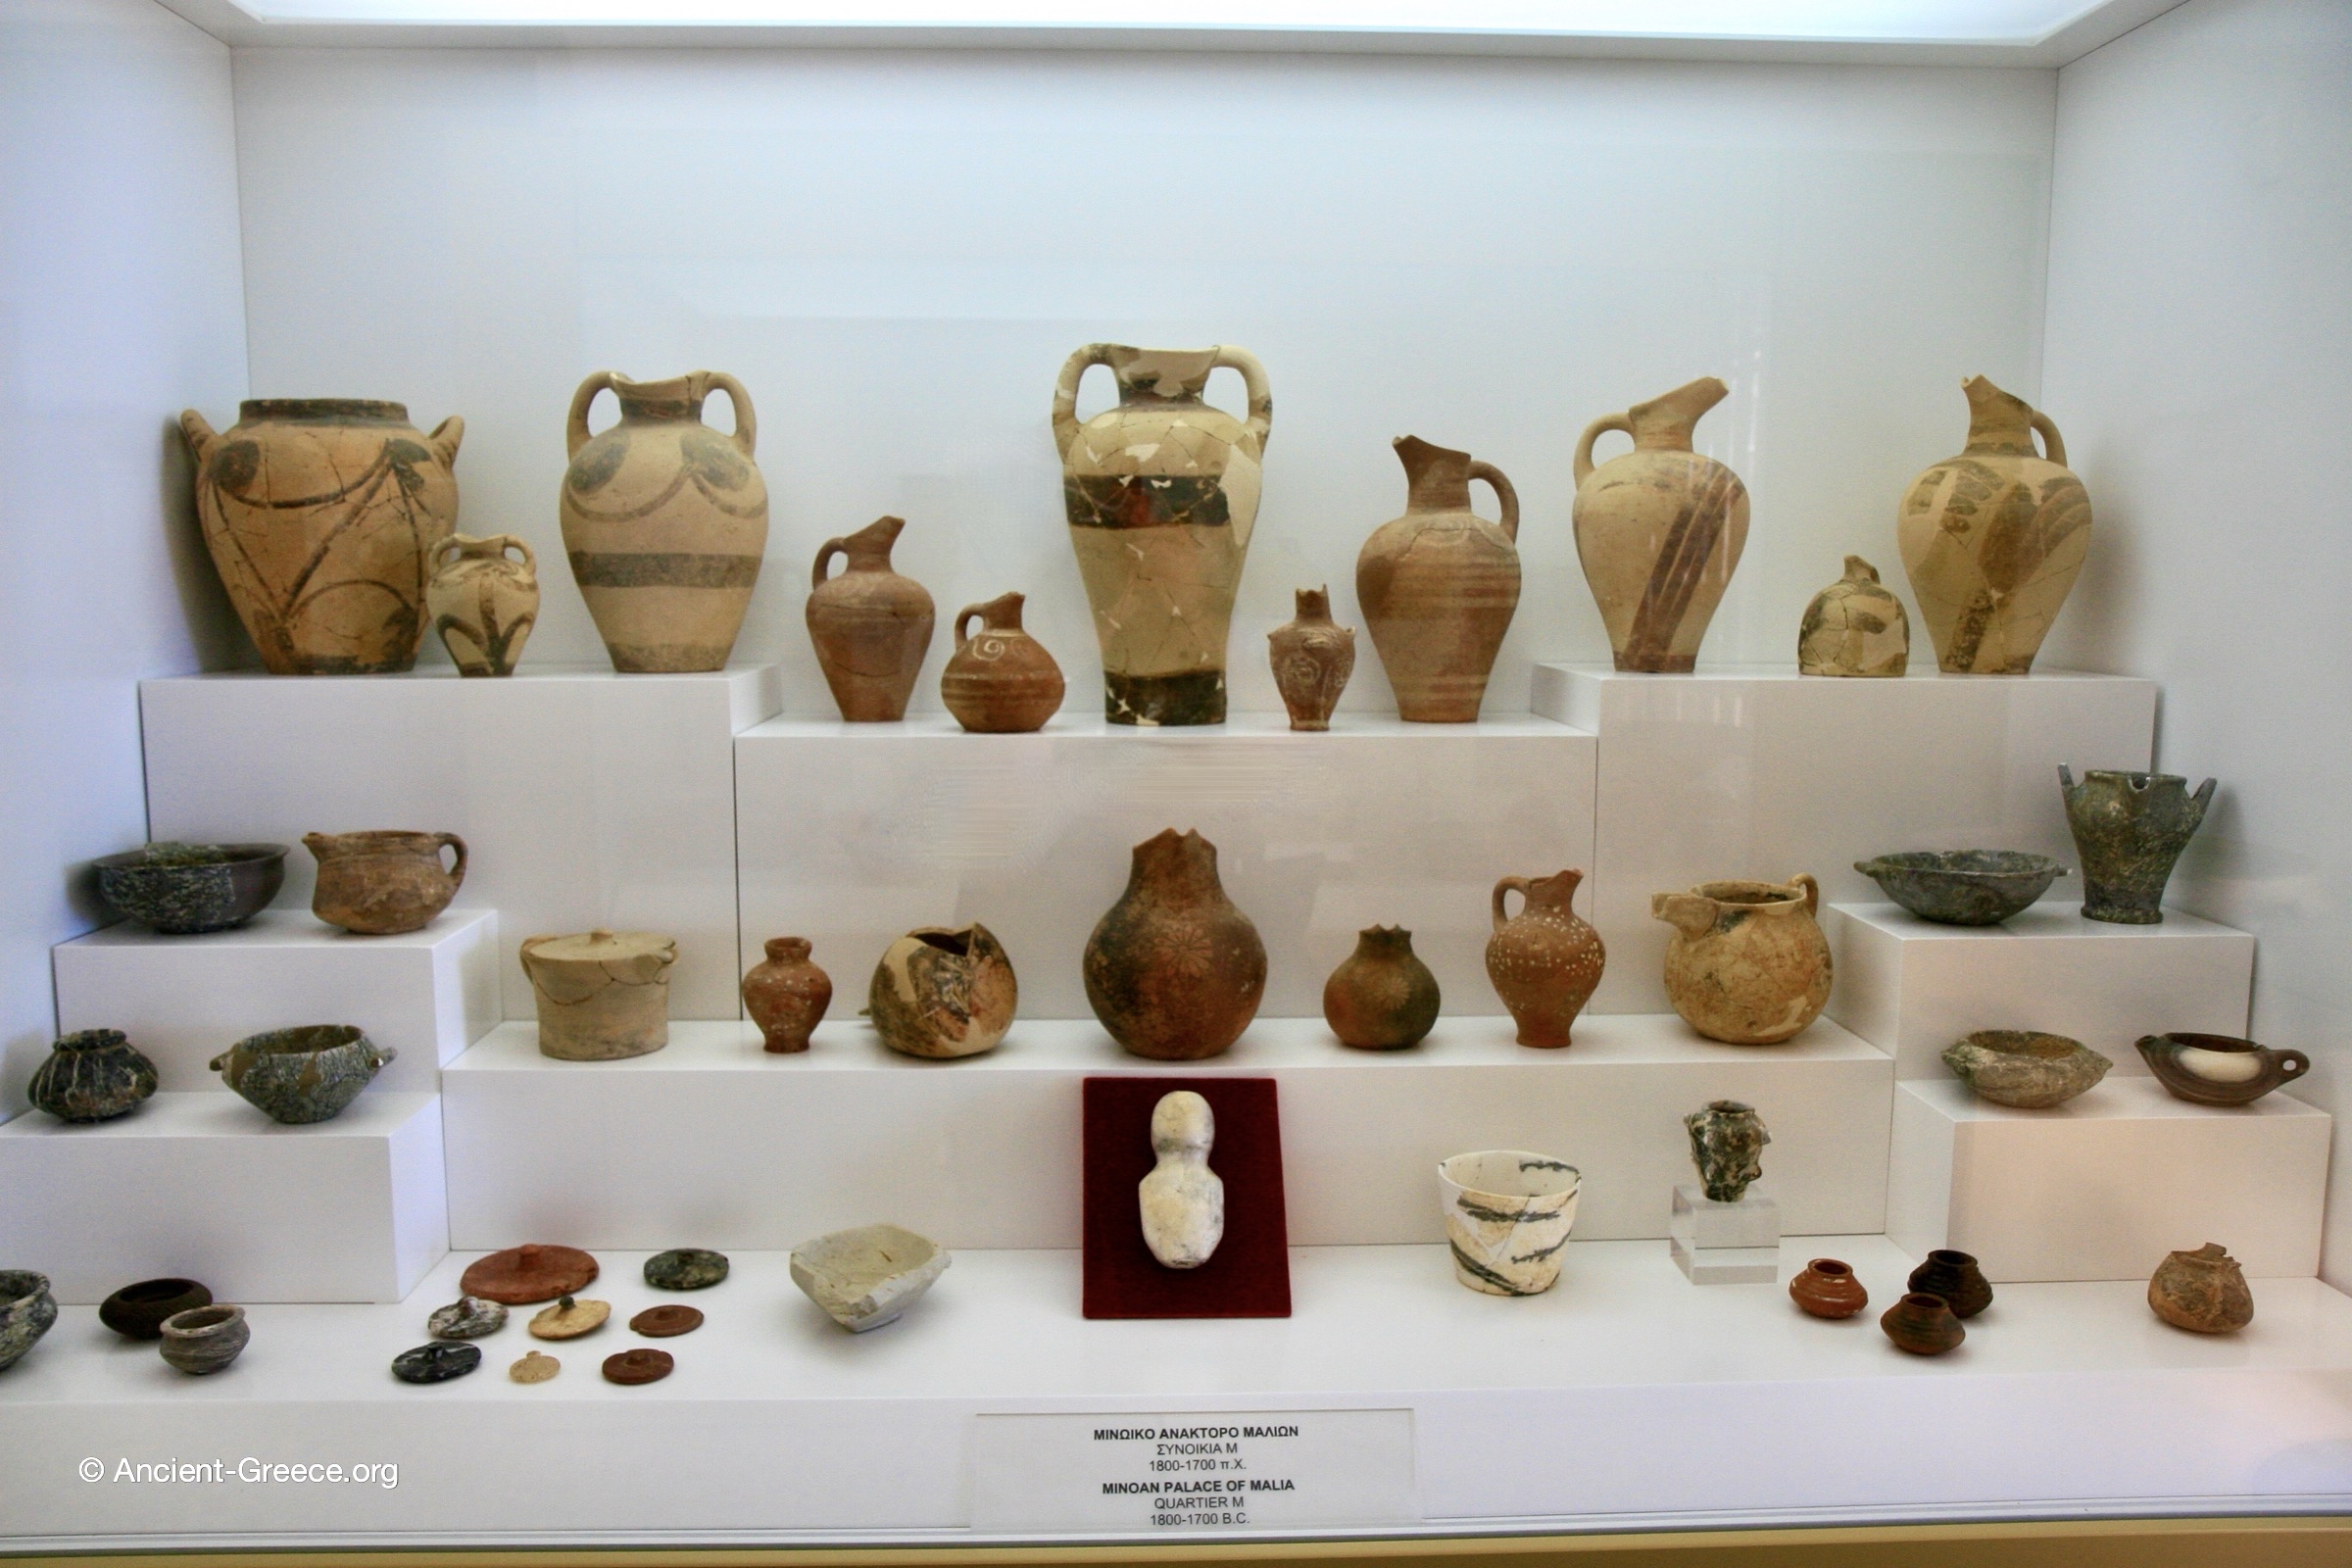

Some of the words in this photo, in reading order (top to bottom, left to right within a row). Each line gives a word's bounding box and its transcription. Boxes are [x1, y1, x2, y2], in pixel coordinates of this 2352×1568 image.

[1094, 1428, 1155, 1441] ΜΙΝΩΙΚΟ
[1159, 1427, 1239, 1440] ΑΝΑΚΤΟΡΟ
[1243, 1426, 1298, 1438] ΜΑΛΙΩΝ
[1156, 1444, 1222, 1455] ΣΥΝΟΙΚΙΑ
[1150, 1459, 1216, 1472] 1800-1700
[1220, 1458, 1247, 1470] π.Χ.
[1102, 1482, 1159, 1494] MINOAN
[1164, 1481, 1222, 1493] PALACE
[1226, 1480, 1246, 1492] OF
[1250, 1480, 1295, 1491] MALIA
[1154, 1497, 1228, 1510] QUARTIER
[1232, 1496, 1245, 1507] M
[1151, 1513, 1218, 1526] 1800-1700
[1222, 1512, 1250, 1524] B.C.
